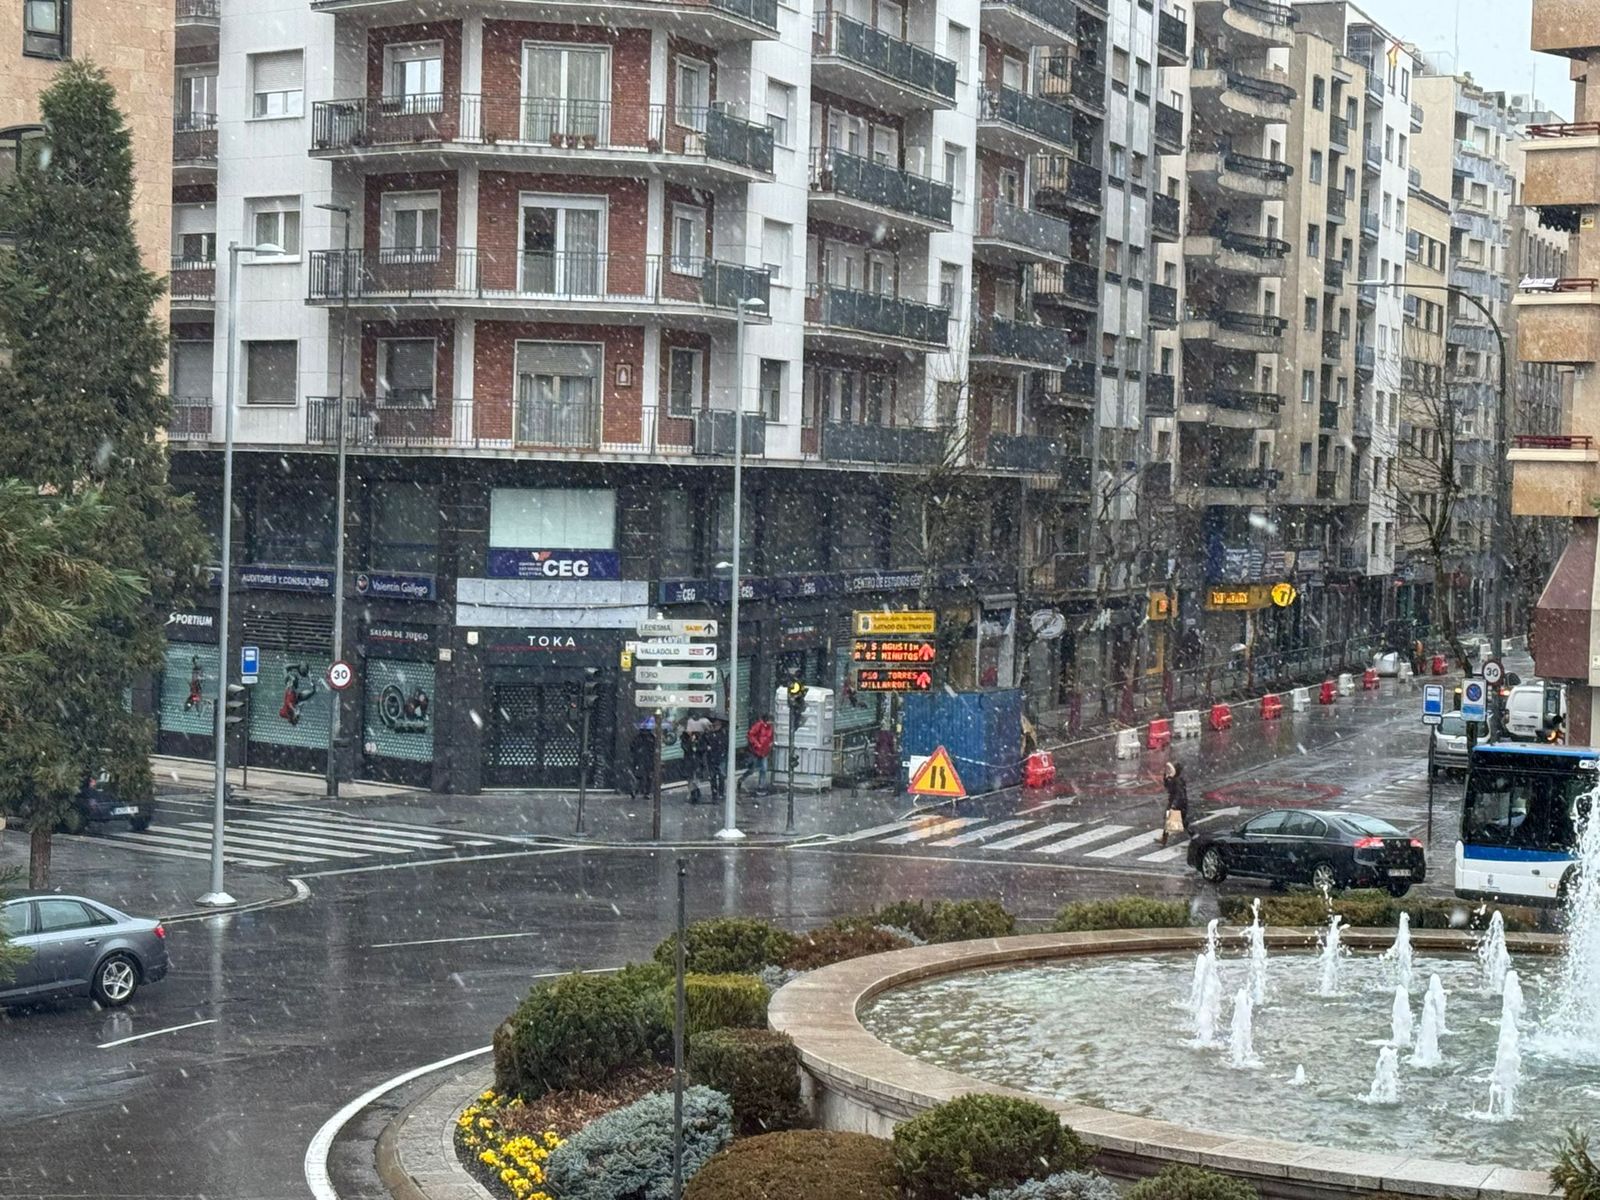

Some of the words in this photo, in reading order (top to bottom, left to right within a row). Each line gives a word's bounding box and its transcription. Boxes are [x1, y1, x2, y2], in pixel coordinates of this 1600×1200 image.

[542, 559, 590, 577] CEG
[241, 573, 277, 584] AUDITORES
[283, 577, 329, 587] CONSULTORES
[876, 576, 883, 588] DE
[401, 582, 428, 597] Gallego
[682, 588, 696, 601] CEG
[163, 611, 213, 627] SPORTIUM
[394, 630, 402, 639] DE
[405, 631, 429, 640] JUEGO
[527, 635, 576, 647] TOKA
[881, 642, 919, 650] AGUSTIN
[881, 651, 919, 660] MINUTOS
[333, 670, 348, 680] 30
[888, 671, 919, 680] TORRES
[1486, 667, 1499, 677] 30
[860, 680, 911, 689] VILLARROEL
